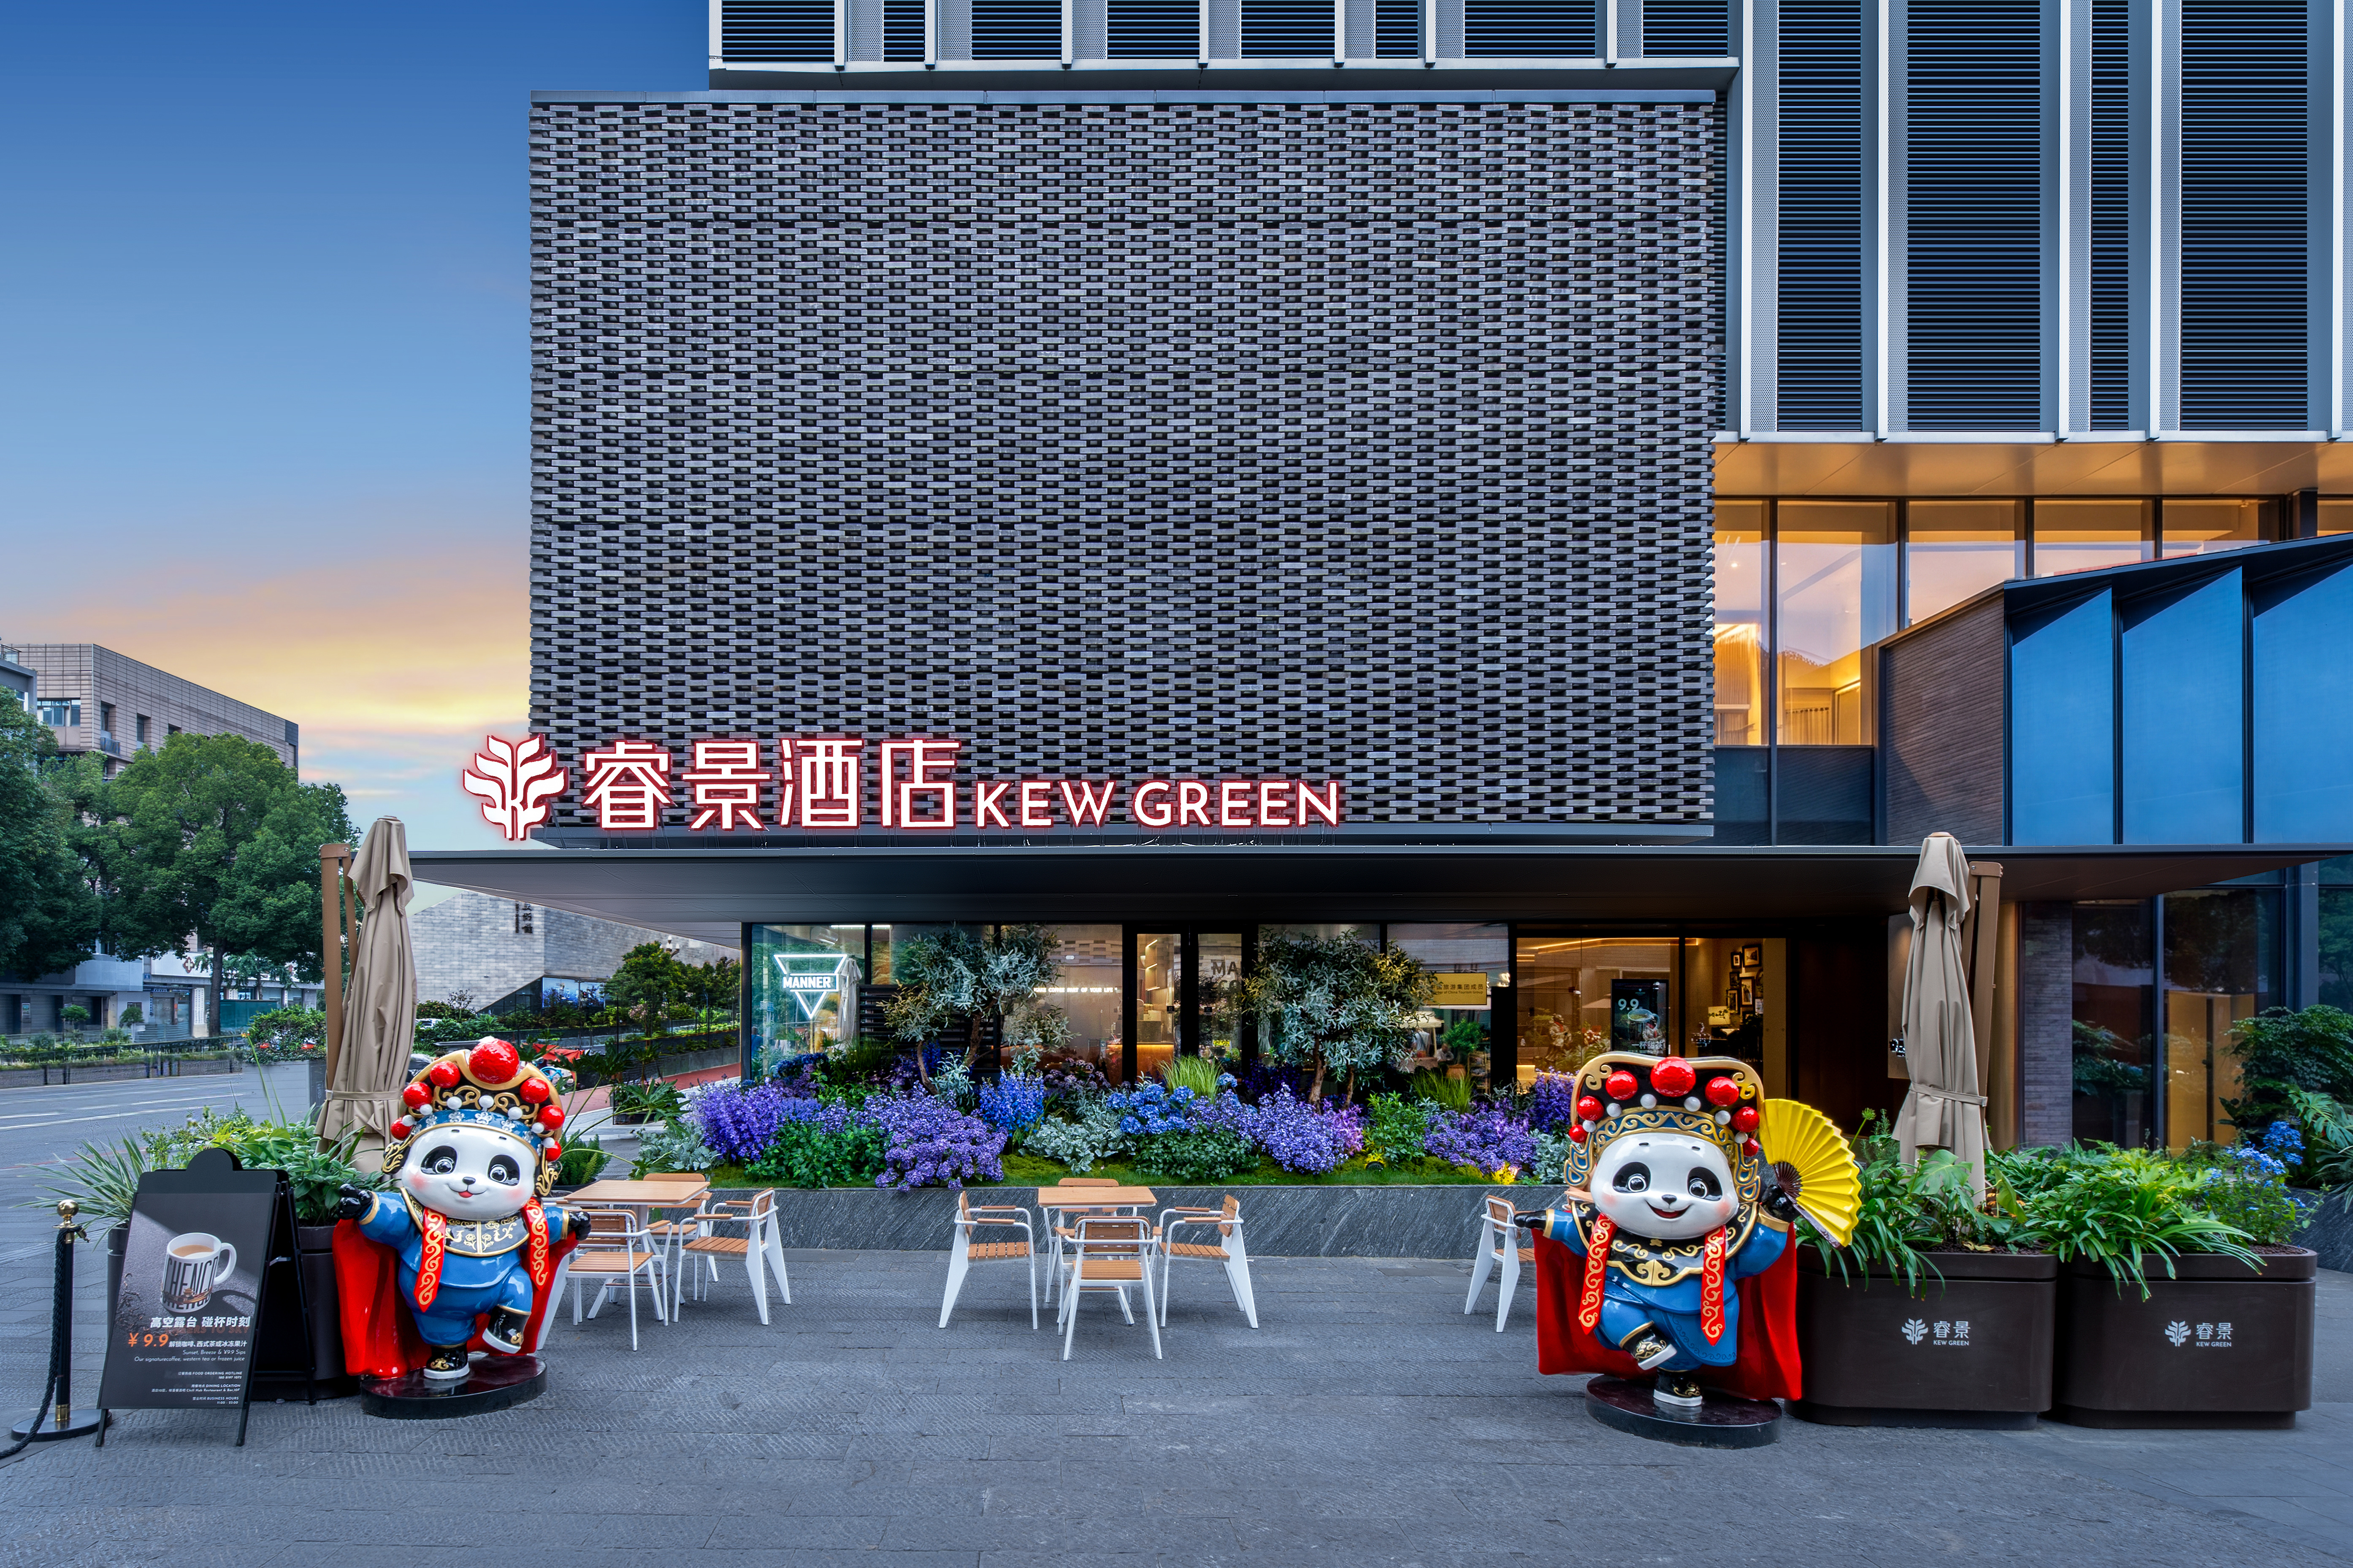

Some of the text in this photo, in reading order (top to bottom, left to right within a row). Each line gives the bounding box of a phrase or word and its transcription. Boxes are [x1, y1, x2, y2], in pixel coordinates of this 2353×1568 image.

[584, 737, 1340, 831] 睿景酒店 KEW GREEN
[783, 976, 831, 988] MANNER
[1618, 999, 1639, 1010] 9.9
[150, 1316, 251, 1328] 高空露台 碰杯时刻
[228, 1325, 250, 1334] SKY
[1933, 1321, 1971, 1338] 睿景
[2196, 1322, 2233, 1339] 睿景
[144, 1334, 169, 1347] 9.9
